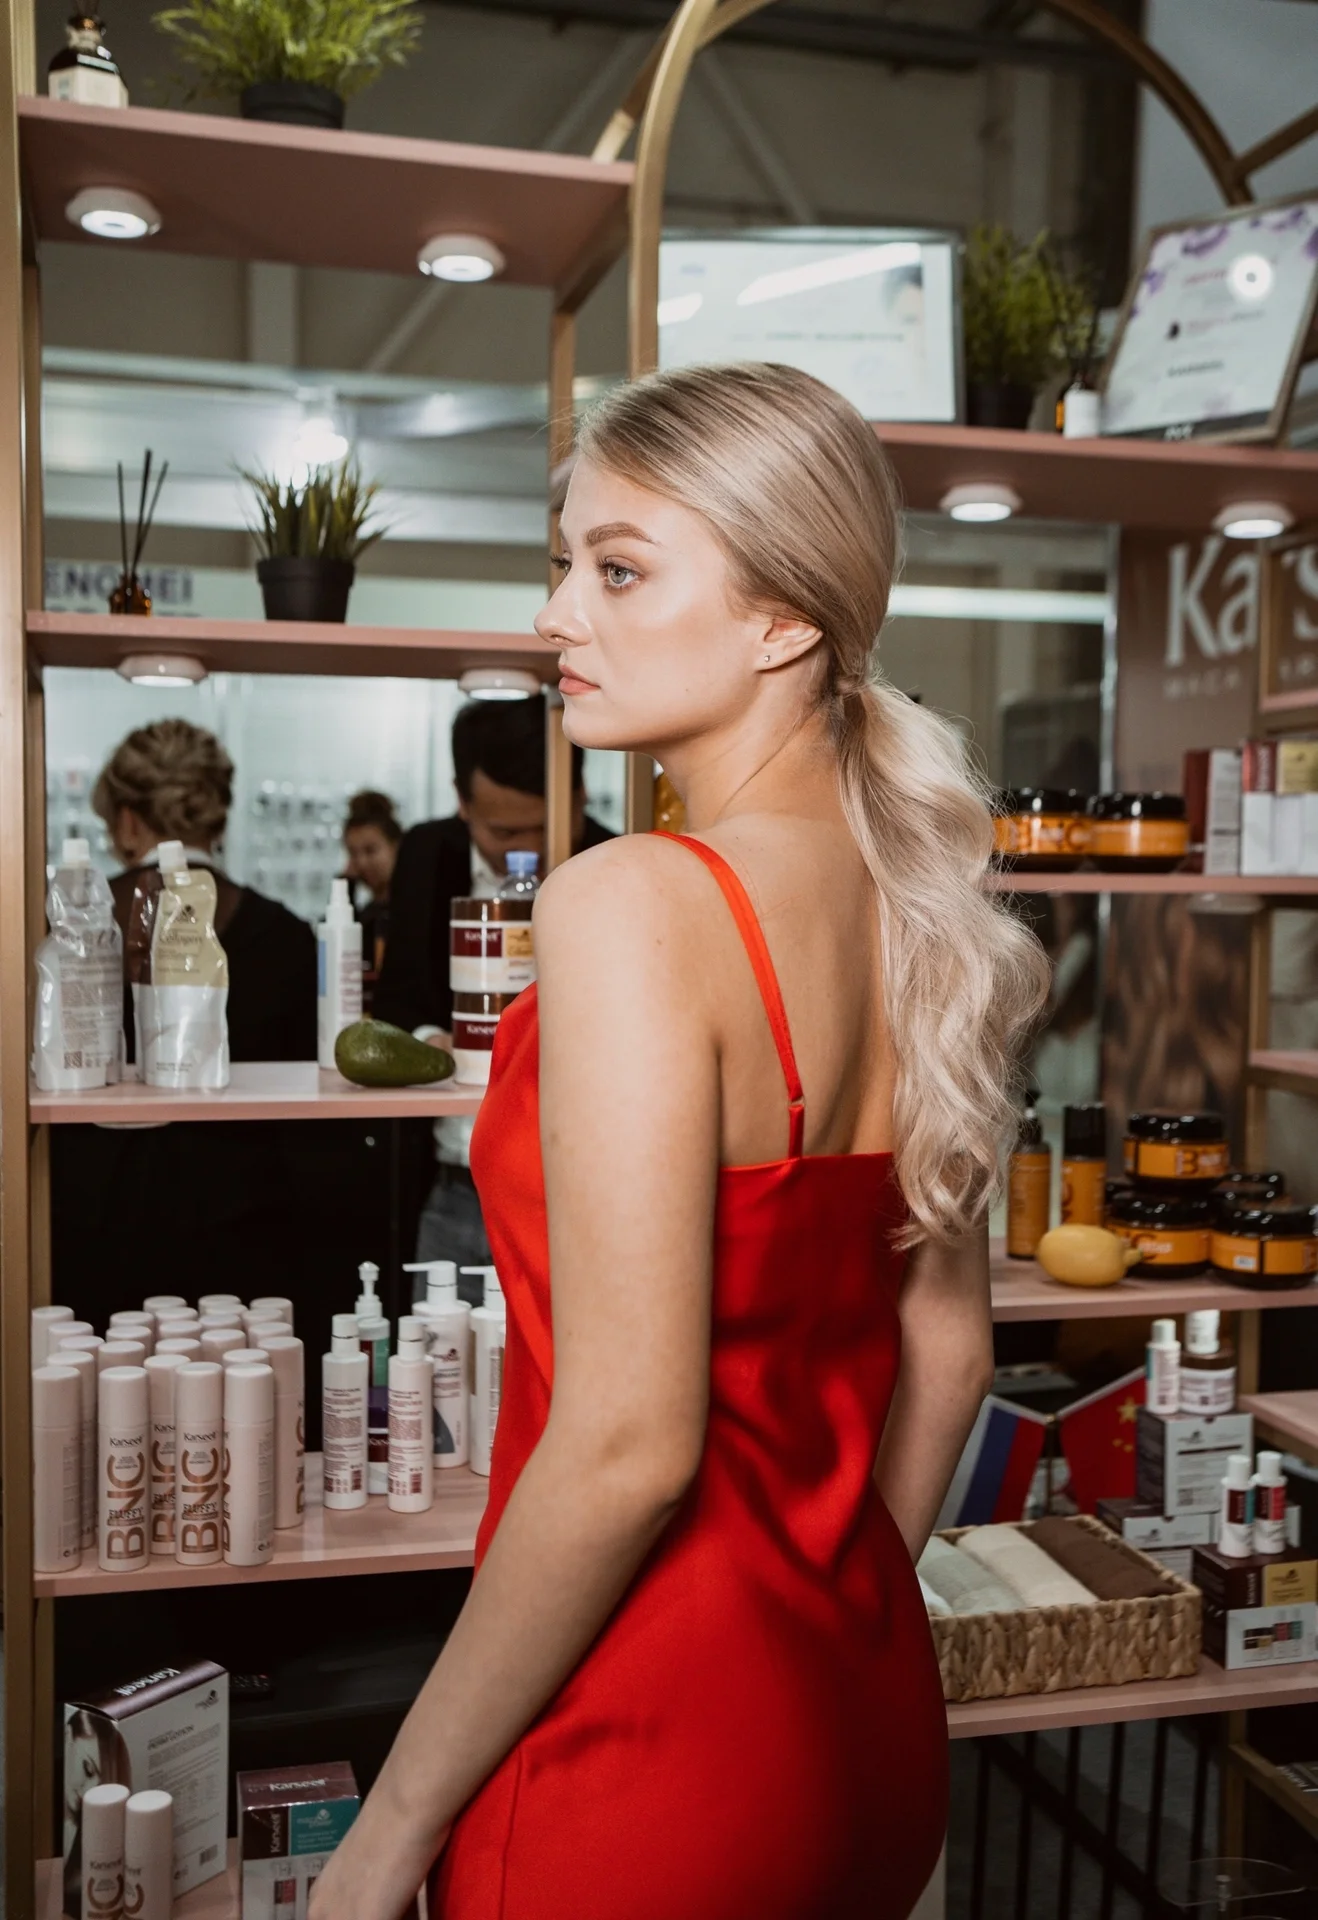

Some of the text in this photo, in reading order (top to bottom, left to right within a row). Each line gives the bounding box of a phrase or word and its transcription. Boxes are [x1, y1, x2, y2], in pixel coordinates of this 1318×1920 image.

[464, 930, 500, 942] Karsell
[106, 1451, 145, 1560] BNC
[181, 1447, 219, 1553] BNC
